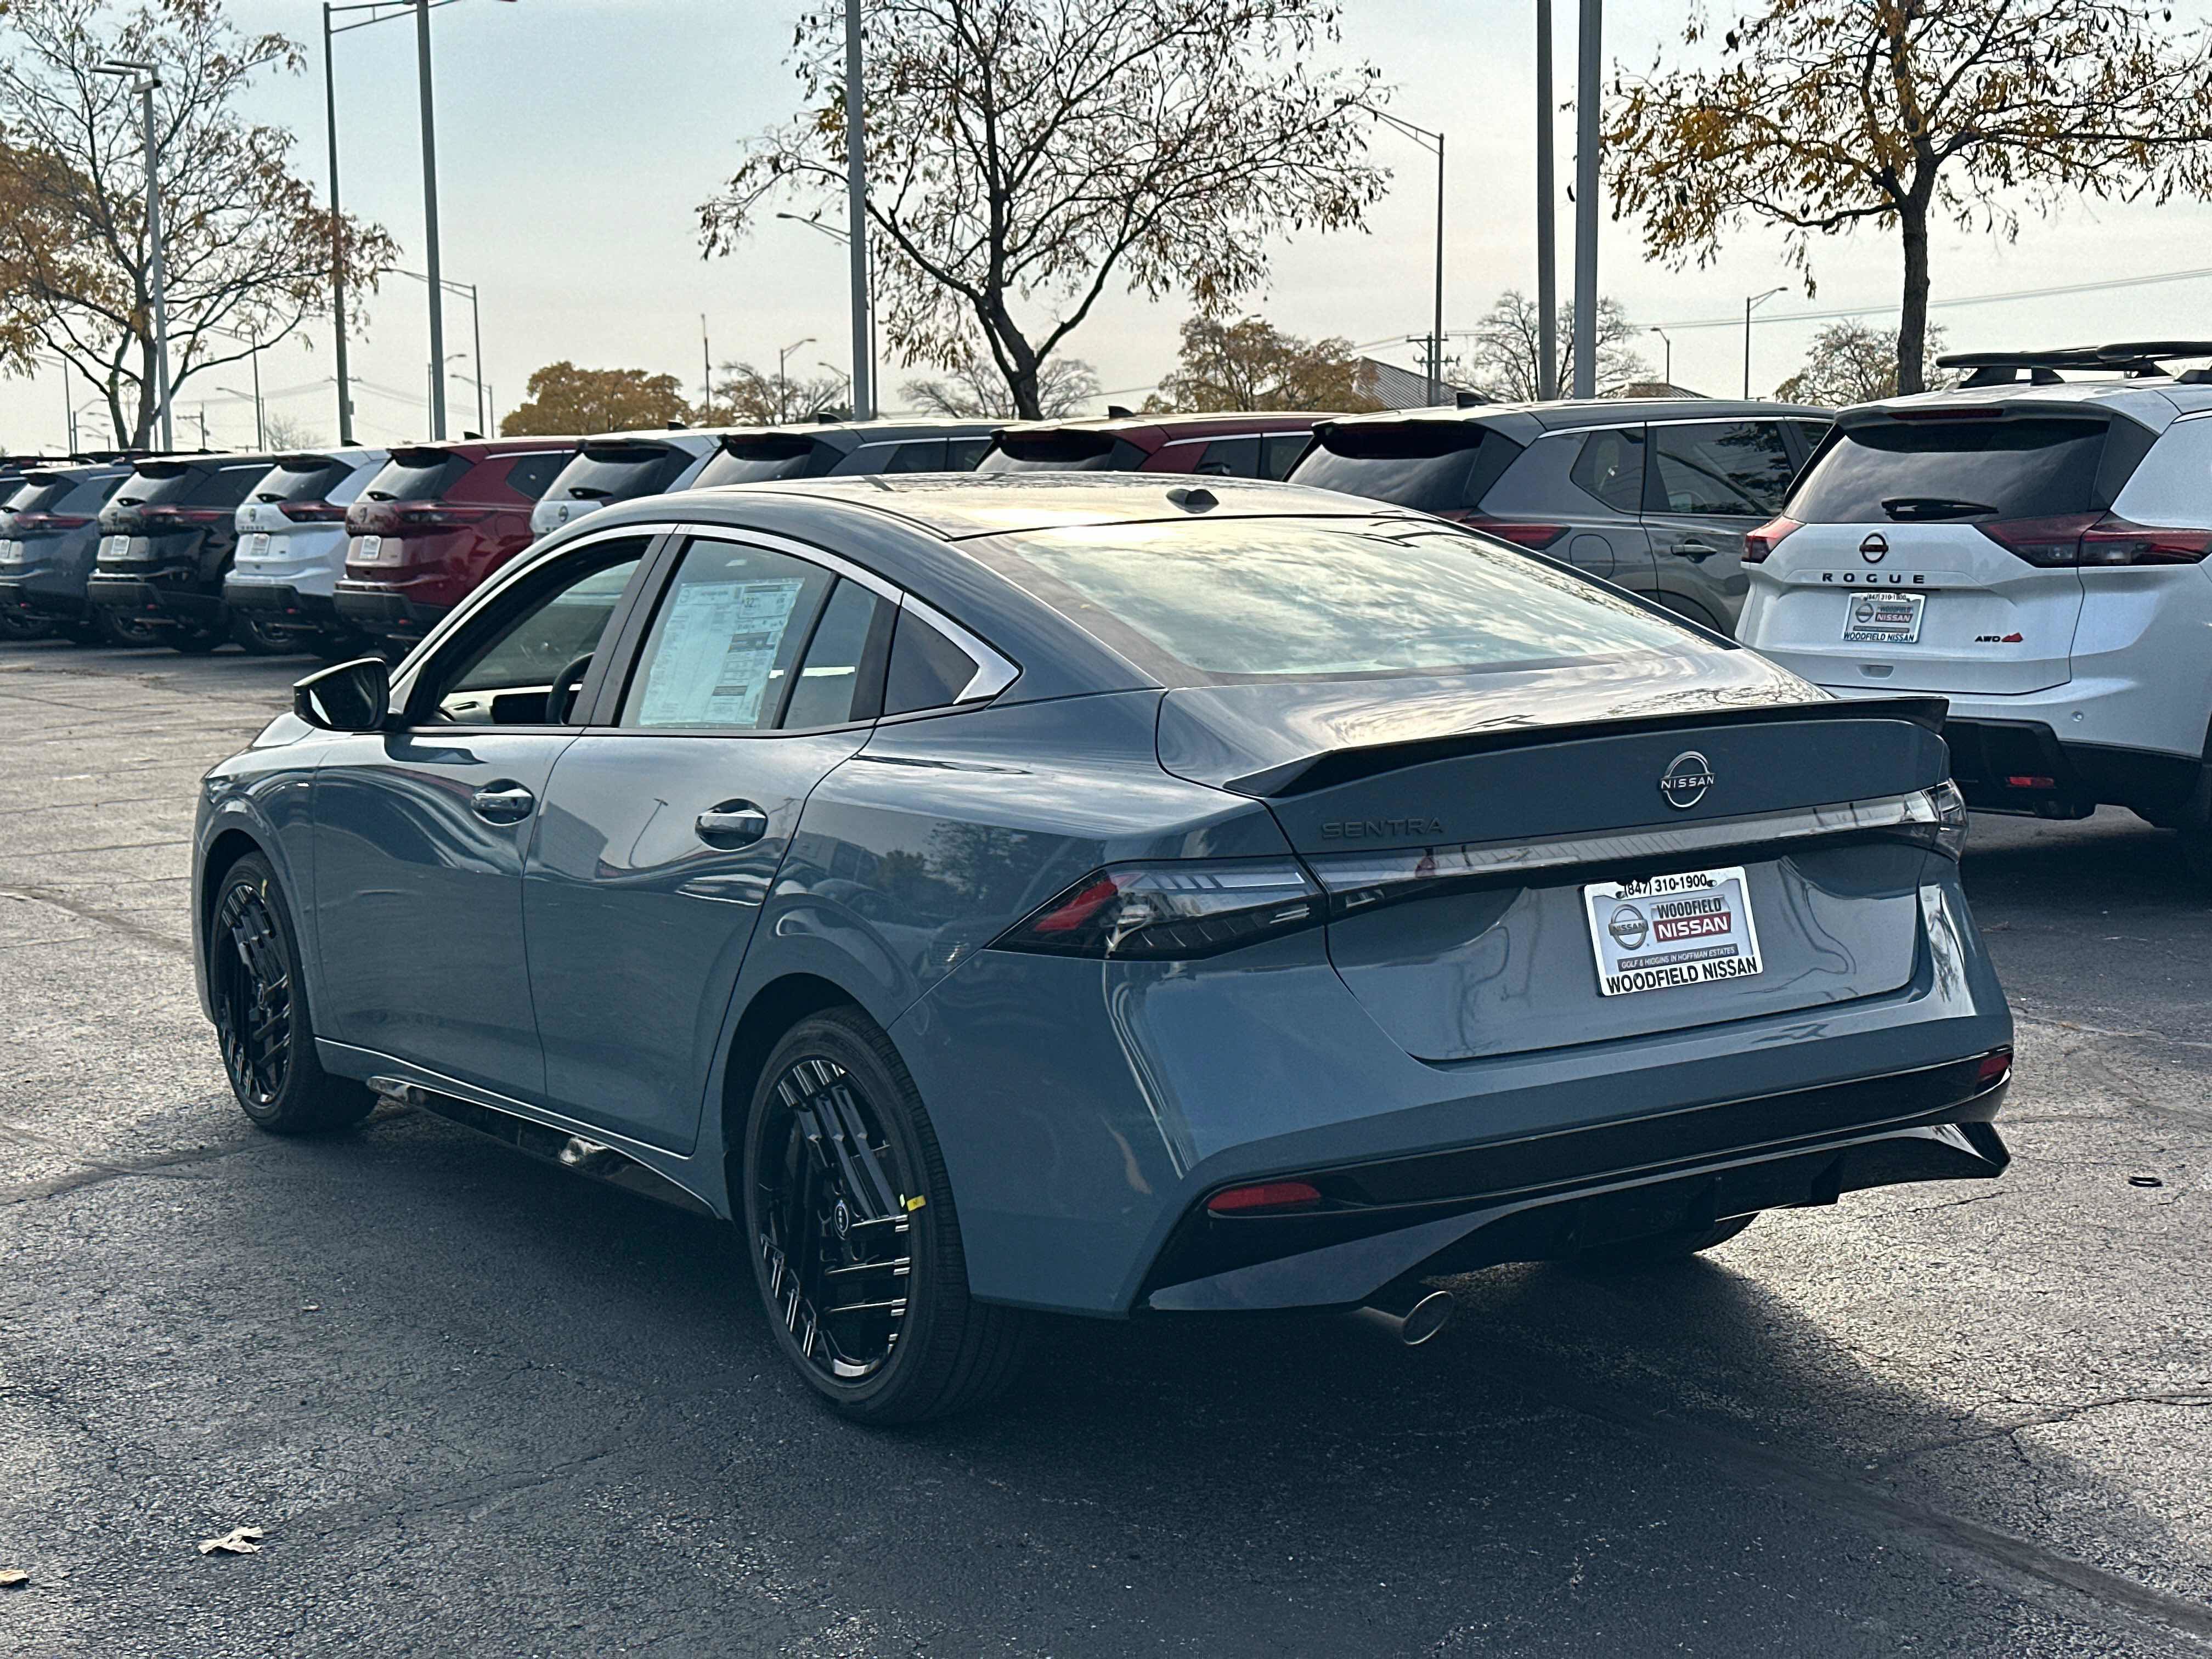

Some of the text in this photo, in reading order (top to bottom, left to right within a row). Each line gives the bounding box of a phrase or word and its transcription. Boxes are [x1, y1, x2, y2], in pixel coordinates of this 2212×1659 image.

[1822, 573, 1925, 584] ROGUE
[1844, 631, 1914, 641] WOODFIELD NISSAN
[1661, 776, 1714, 789] NISSAN
[1322, 817, 1443, 838] SENTRA
[1624, 873, 1707, 898] (847) 310-1900
[1657, 898, 1722, 919] WOODFIELD
[1613, 923, 1645, 931] NISSAN
[1658, 916, 1728, 939] NISSAN
[1622, 960, 1638, 969] GOLF
[1678, 951, 1708, 961] HOFFMAN
[1708, 946, 1735, 956] ESTATES
[1606, 956, 1757, 994] WOODFIELD NISSAN
